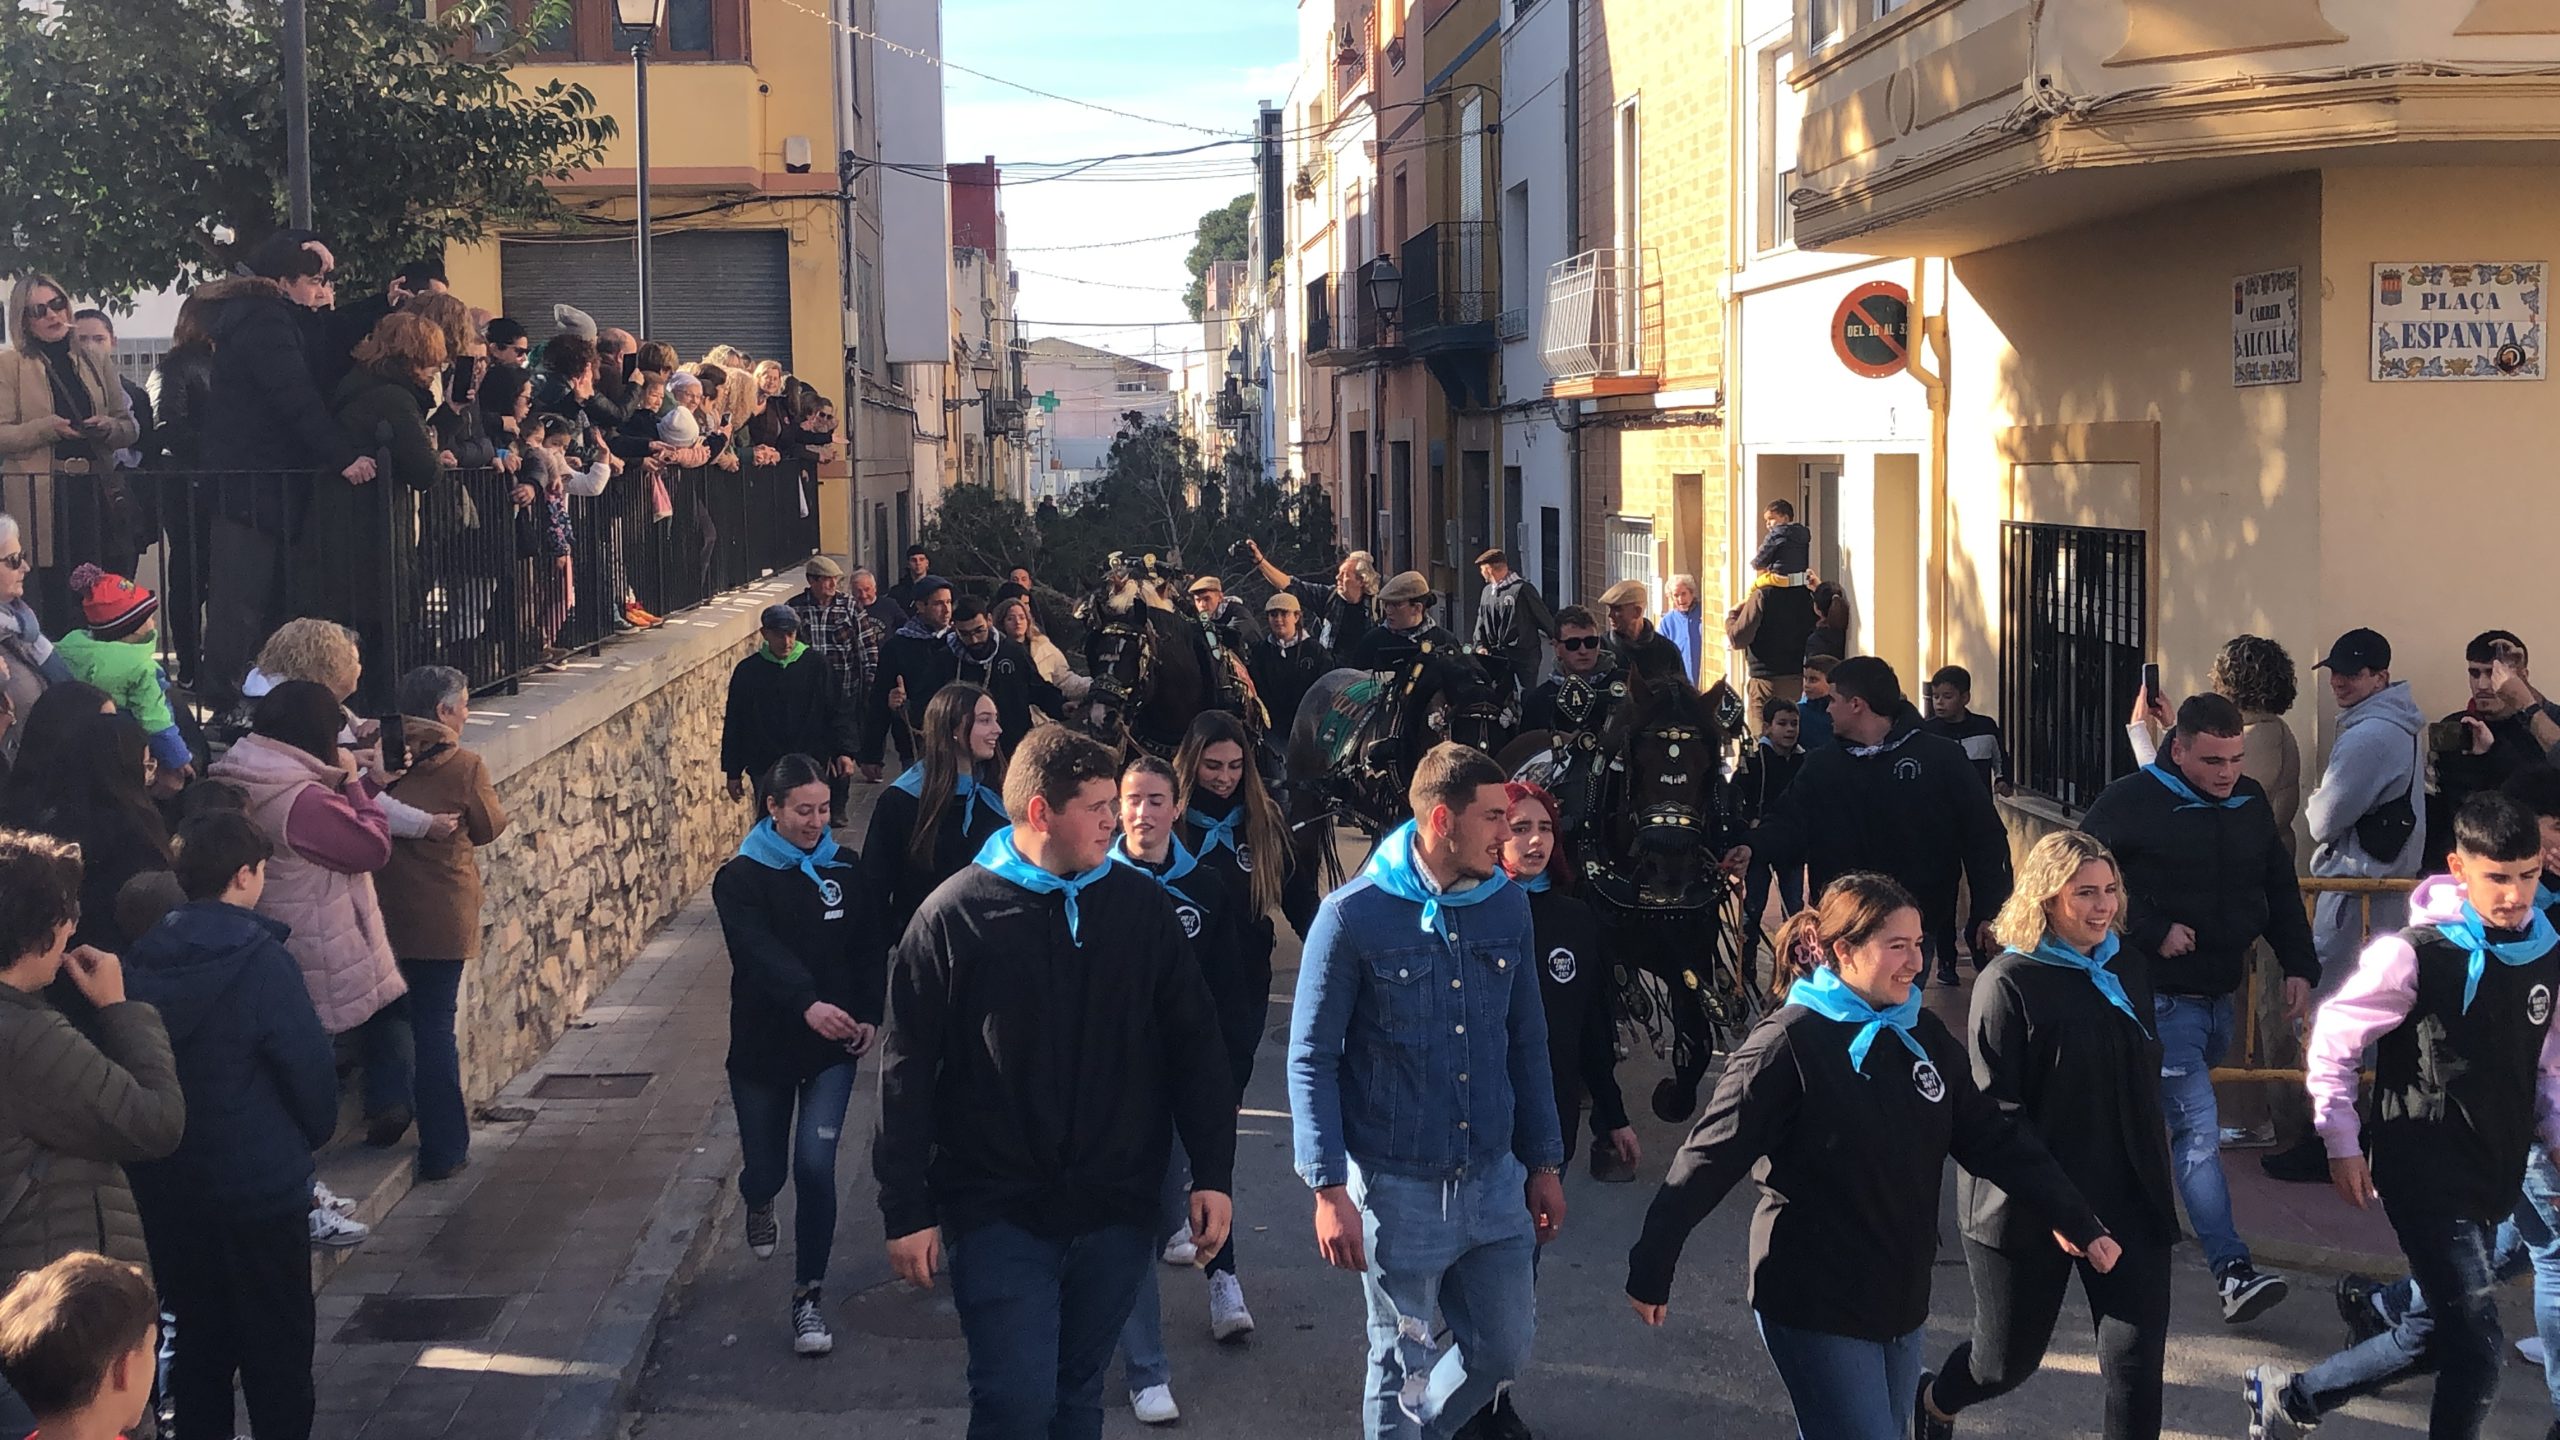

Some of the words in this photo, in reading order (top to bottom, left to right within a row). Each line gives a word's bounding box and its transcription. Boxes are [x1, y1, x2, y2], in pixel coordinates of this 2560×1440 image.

[2250, 304, 2281, 323] CARRER
[2421, 292, 2501, 314] PLAÇA
[1847, 324, 1865, 338] DEL
[1868, 323, 1880, 337] 16
[1884, 322, 1895, 336] AL
[1899, 322, 1907, 335] 3
[2243, 321, 2288, 358] ALCALÁ
[2402, 322, 2519, 349] ESPANYA
